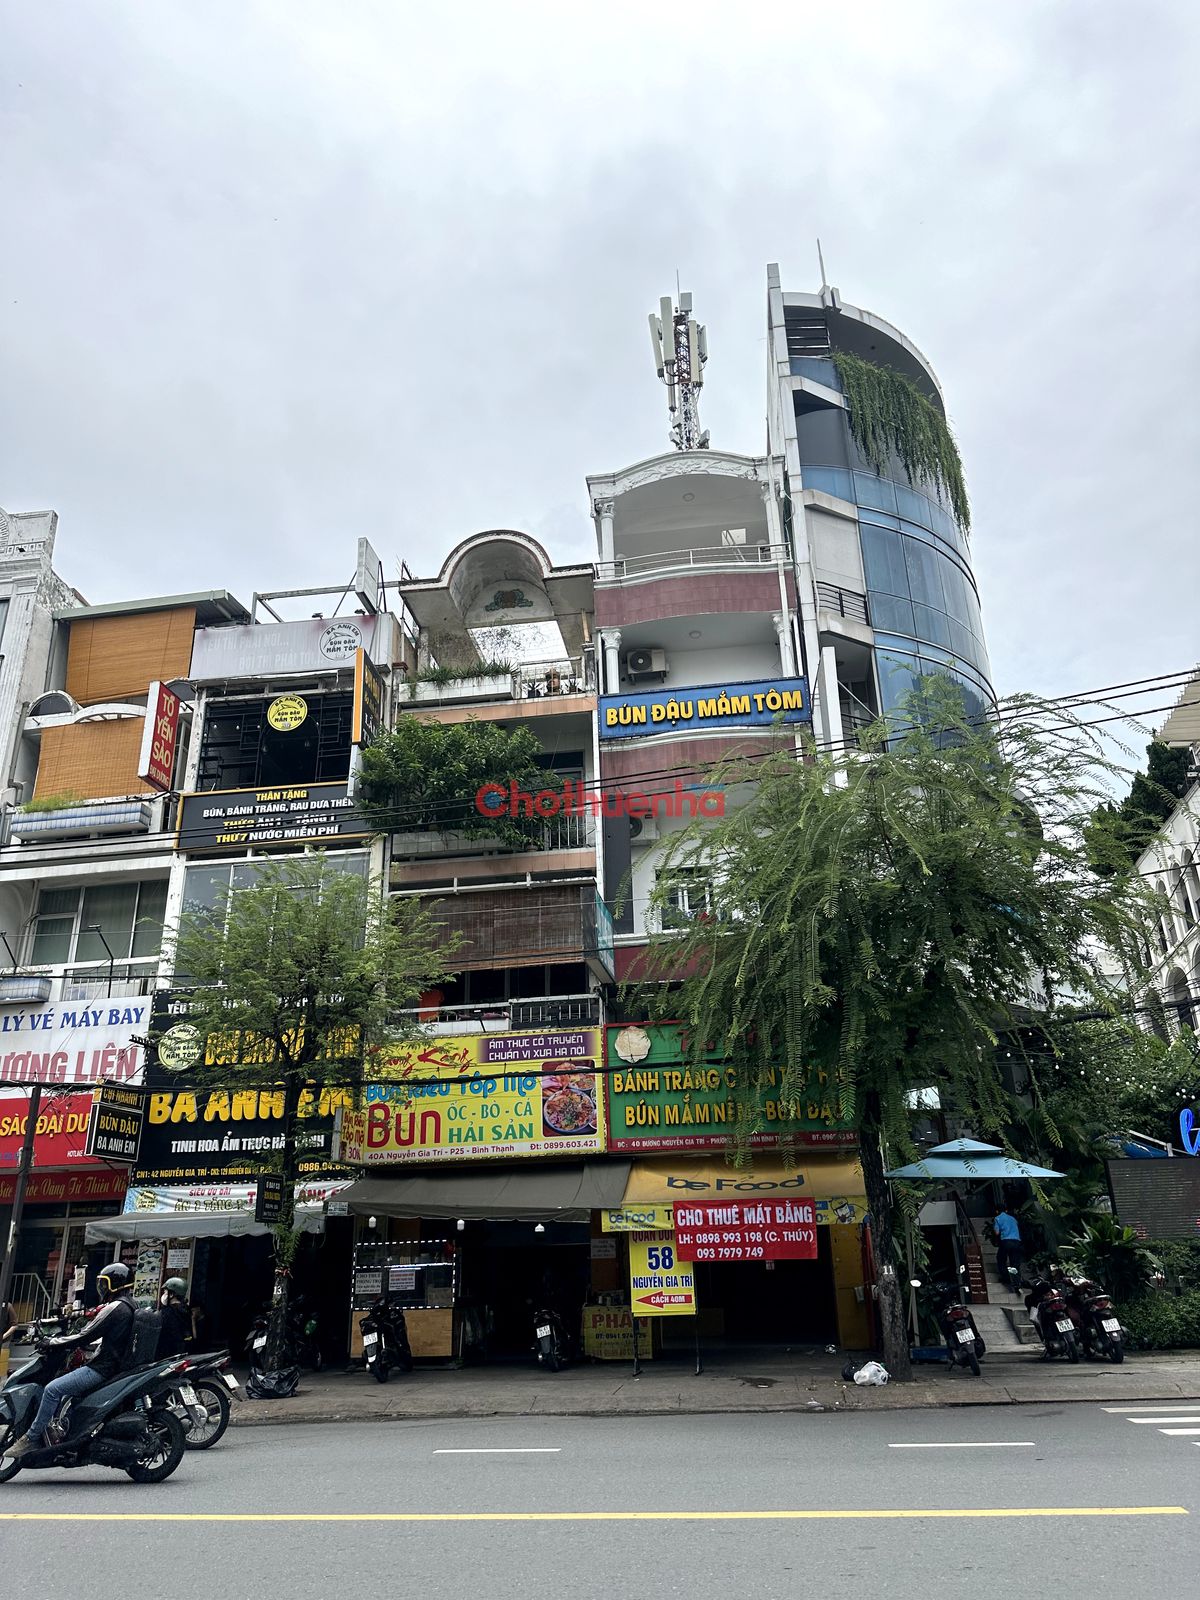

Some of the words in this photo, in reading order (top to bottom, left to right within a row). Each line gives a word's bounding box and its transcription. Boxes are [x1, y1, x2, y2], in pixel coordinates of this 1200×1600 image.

[606, 703, 647, 727] BÚN
[651, 698, 694, 725] ĐẬU
[698, 690, 751, 718] MẮM
[753, 688, 803, 712] TÔM
[152, 740, 171, 769] SÀO
[227, 805, 253, 816] BÁNH
[290, 801, 309, 811] RAU
[311, 799, 329, 809] DƯA
[256, 791, 280, 802] THÂN
[282, 790, 307, 801] TẶNG
[249, 829, 283, 840] NƯỚC
[284, 826, 317, 839] MIỄN
[318, 825, 339, 836] PHÍ
[2, 1010, 25, 1032] LÝ
[29, 1008, 54, 1031] VÉ
[60, 1006, 104, 1029] MÁY
[107, 1007, 145, 1026] BAY
[74, 1042, 138, 1082] LIÊN
[522, 1050, 531, 1059] VỊ
[614, 1068, 659, 1093] BÁNH
[663, 1065, 720, 1090] TRÁNG
[148, 1090, 198, 1124] BA
[204, 1088, 287, 1122] ANH
[447, 1102, 468, 1121] ỐC
[481, 1102, 500, 1119] BÒ
[514, 1098, 533, 1117] CÁ
[625, 1099, 660, 1126] BÚN
[665, 1093, 710, 1125] MẮM
[36, 1113, 64, 1138] ĐẠI
[99, 1112, 119, 1132] BÚN
[119, 1116, 139, 1138] ĐẬU
[367, 1100, 441, 1148] Bún
[448, 1123, 484, 1143] HẢI
[492, 1118, 534, 1140] SẢN
[97, 1135, 107, 1150] BA
[108, 1137, 123, 1153] ANH
[124, 1139, 136, 1155] EM
[171, 1140, 196, 1153] TINH
[198, 1138, 219, 1152] HOA
[221, 1131, 243, 1151] ẨM
[244, 1136, 271, 1154] THỰC
[368, 1152, 385, 1161] 40A
[386, 1149, 416, 1161] Nguyễn
[417, 1149, 431, 1158] Gia
[432, 1148, 443, 1157] Trí
[450, 1147, 465, 1155] P25
[471, 1145, 488, 1154] Bình
[491, 1144, 515, 1154] Thạnh
[530, 1142, 542, 1150] Đt:
[544, 1140, 598, 1150] 0899.603.421
[151, 1170, 159, 1178] 42
[160, 1167, 184, 1178] NGUYỄN
[185, 1168, 195, 1176] GIA
[197, 1167, 207, 1176] TRÍ
[716, 1175, 805, 1191] Food
[677, 1208, 703, 1226] CHO
[707, 1205, 740, 1225] THUÊ
[744, 1202, 772, 1227] MẶT
[776, 1200, 813, 1224] BẰNG
[678, 1234, 693, 1244] LH:
[696, 1233, 720, 1244] 0898
[723, 1232, 742, 1243] 993
[745, 1232, 762, 1243] 198
[765, 1230, 780, 1243] (C.
[783, 1228, 814, 1243] THÚY)
[647, 1246, 674, 1270] 58
[697, 1248, 715, 1259] 093
[718, 1247, 743, 1258] 7979
[745, 1247, 764, 1257] 749
[632, 1272, 663, 1288] NGUYỄN
[666, 1276, 678, 1287] GIA
[680, 1272, 693, 1287] TRÍ
[883, 1265, 893, 1275] 11
[273, 1285, 282, 1295] 13
[651, 1294, 670, 1304] CÁCH
[670, 1295, 686, 1303] 40M
